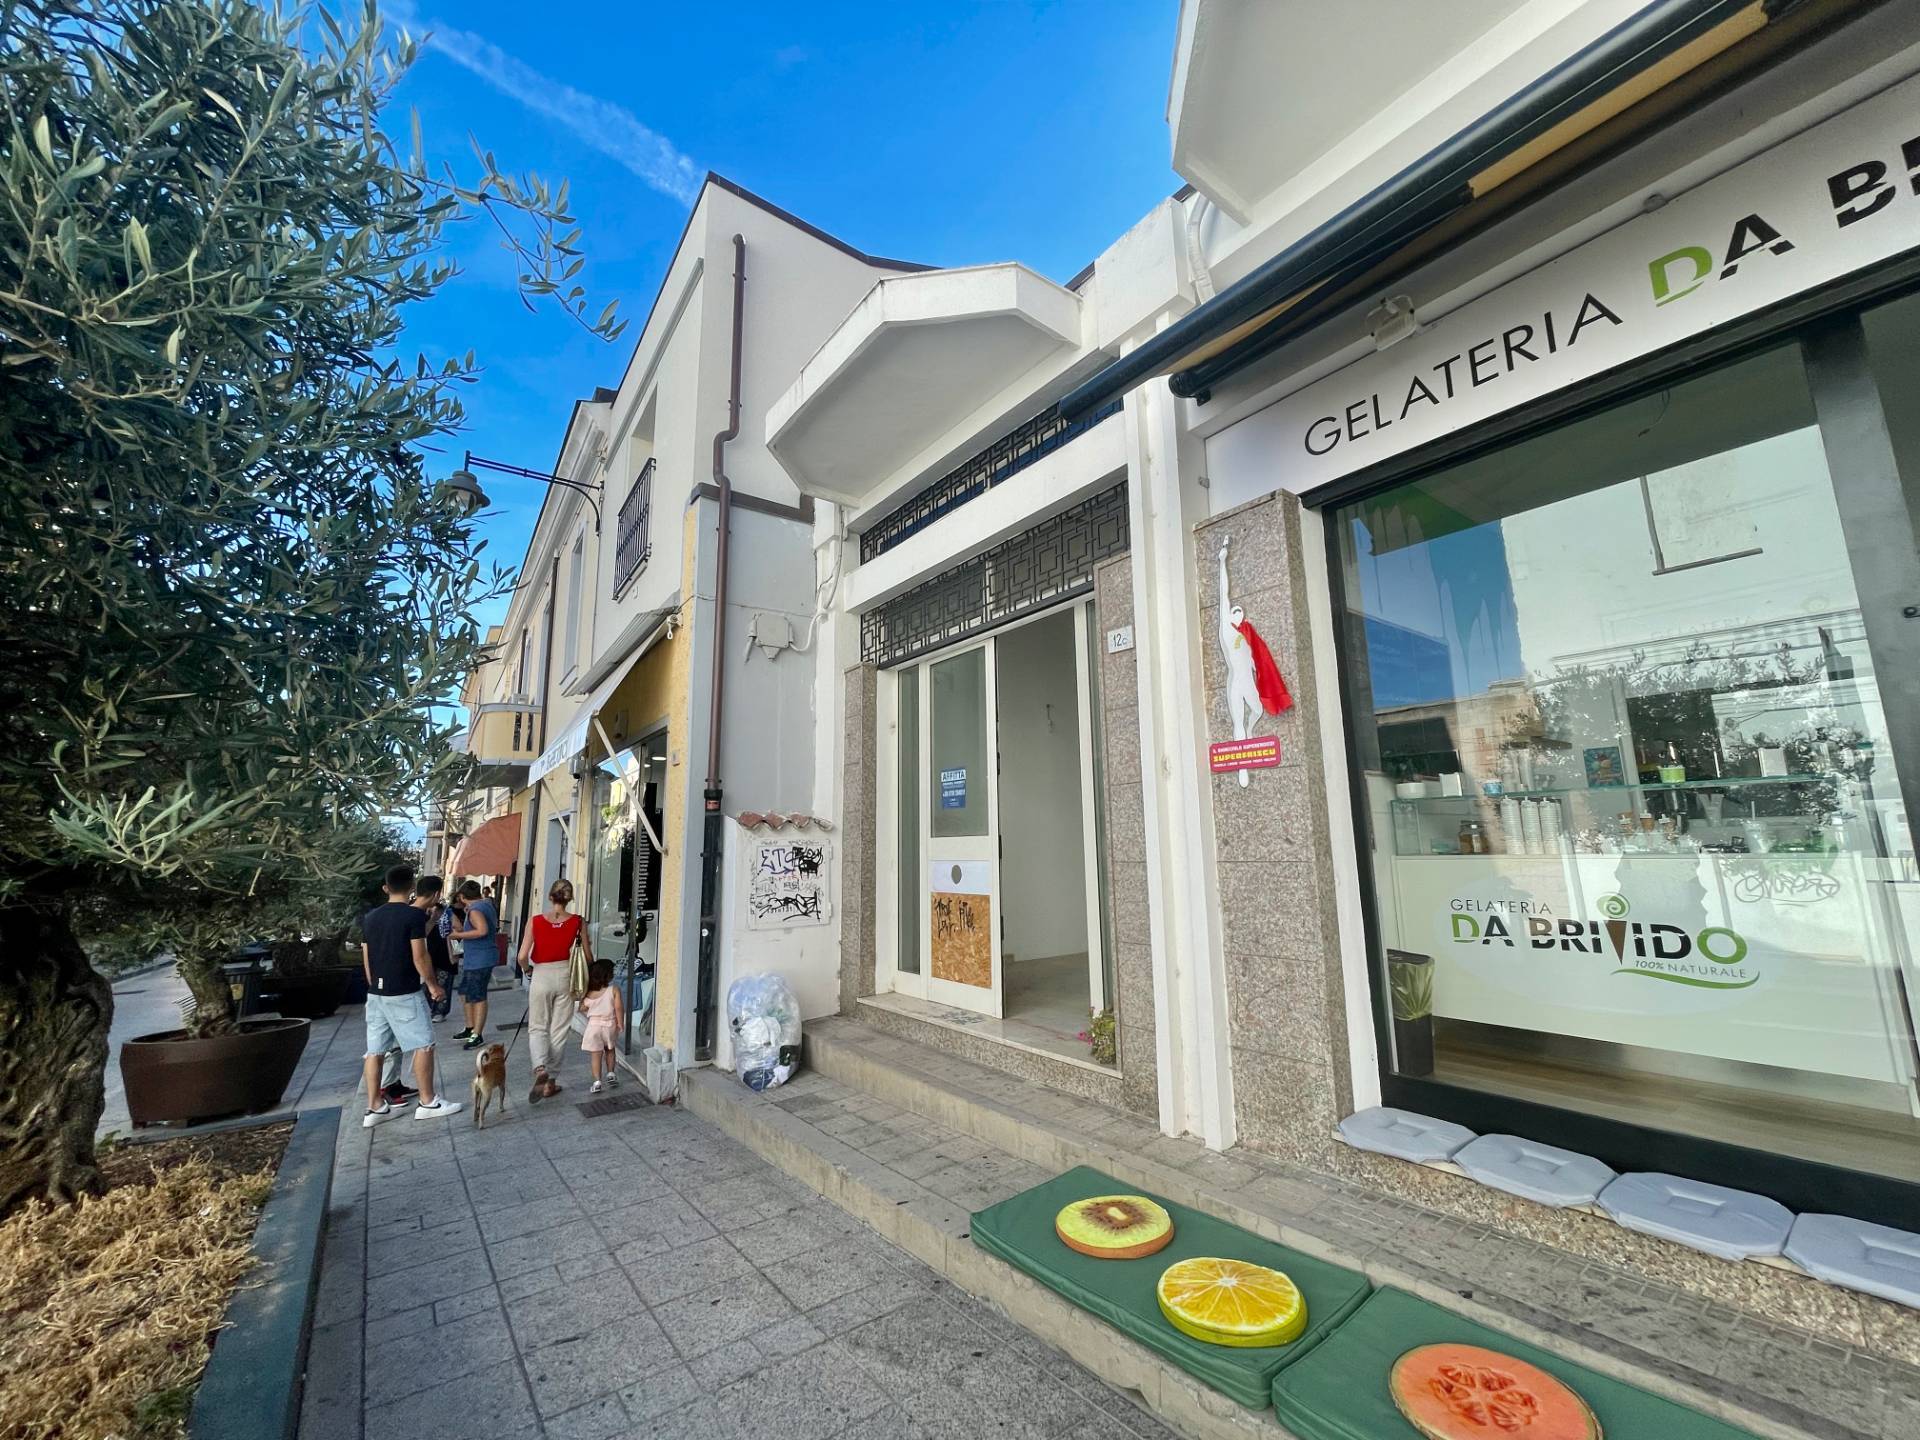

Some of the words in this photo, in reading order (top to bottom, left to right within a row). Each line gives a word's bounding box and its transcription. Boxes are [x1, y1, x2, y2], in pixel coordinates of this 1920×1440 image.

[1304, 293, 1624, 457] GELATERIA
[1648, 212, 1796, 308] DA
[1450, 899, 1552, 914] GELATERIA
[1451, 913, 1514, 947] DA
[1635, 960, 1664, 970] 100%
[1668, 963, 1747, 979] NATURALE
